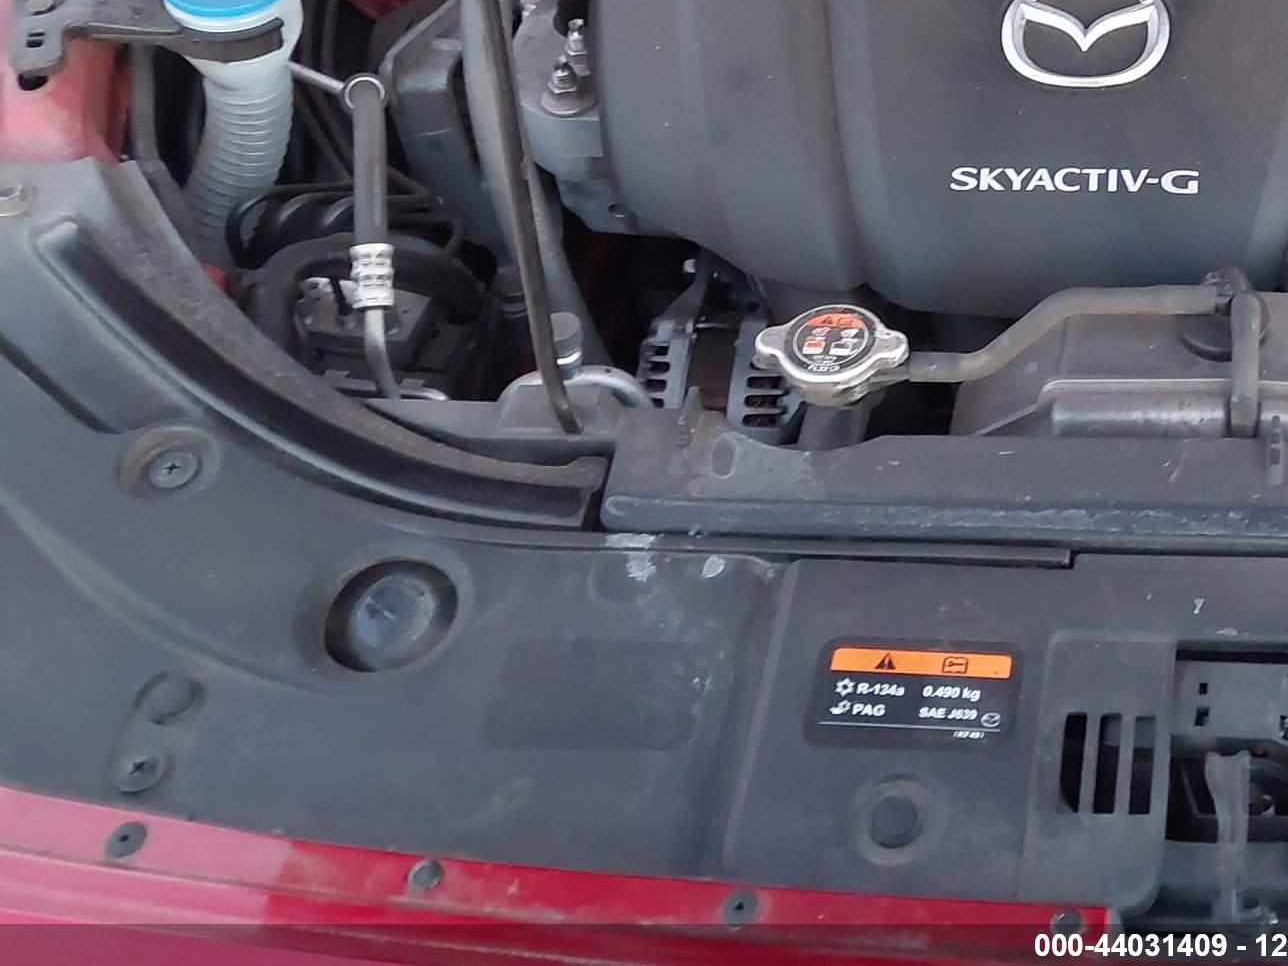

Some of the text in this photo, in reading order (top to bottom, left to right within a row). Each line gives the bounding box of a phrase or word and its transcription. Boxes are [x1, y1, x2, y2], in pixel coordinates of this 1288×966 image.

[948, 166, 1201, 195] SKYACTIV-G
[961, 687, 981, 702] kg
[851, 703, 886, 717] PAG
[918, 707, 946, 719] SAE
